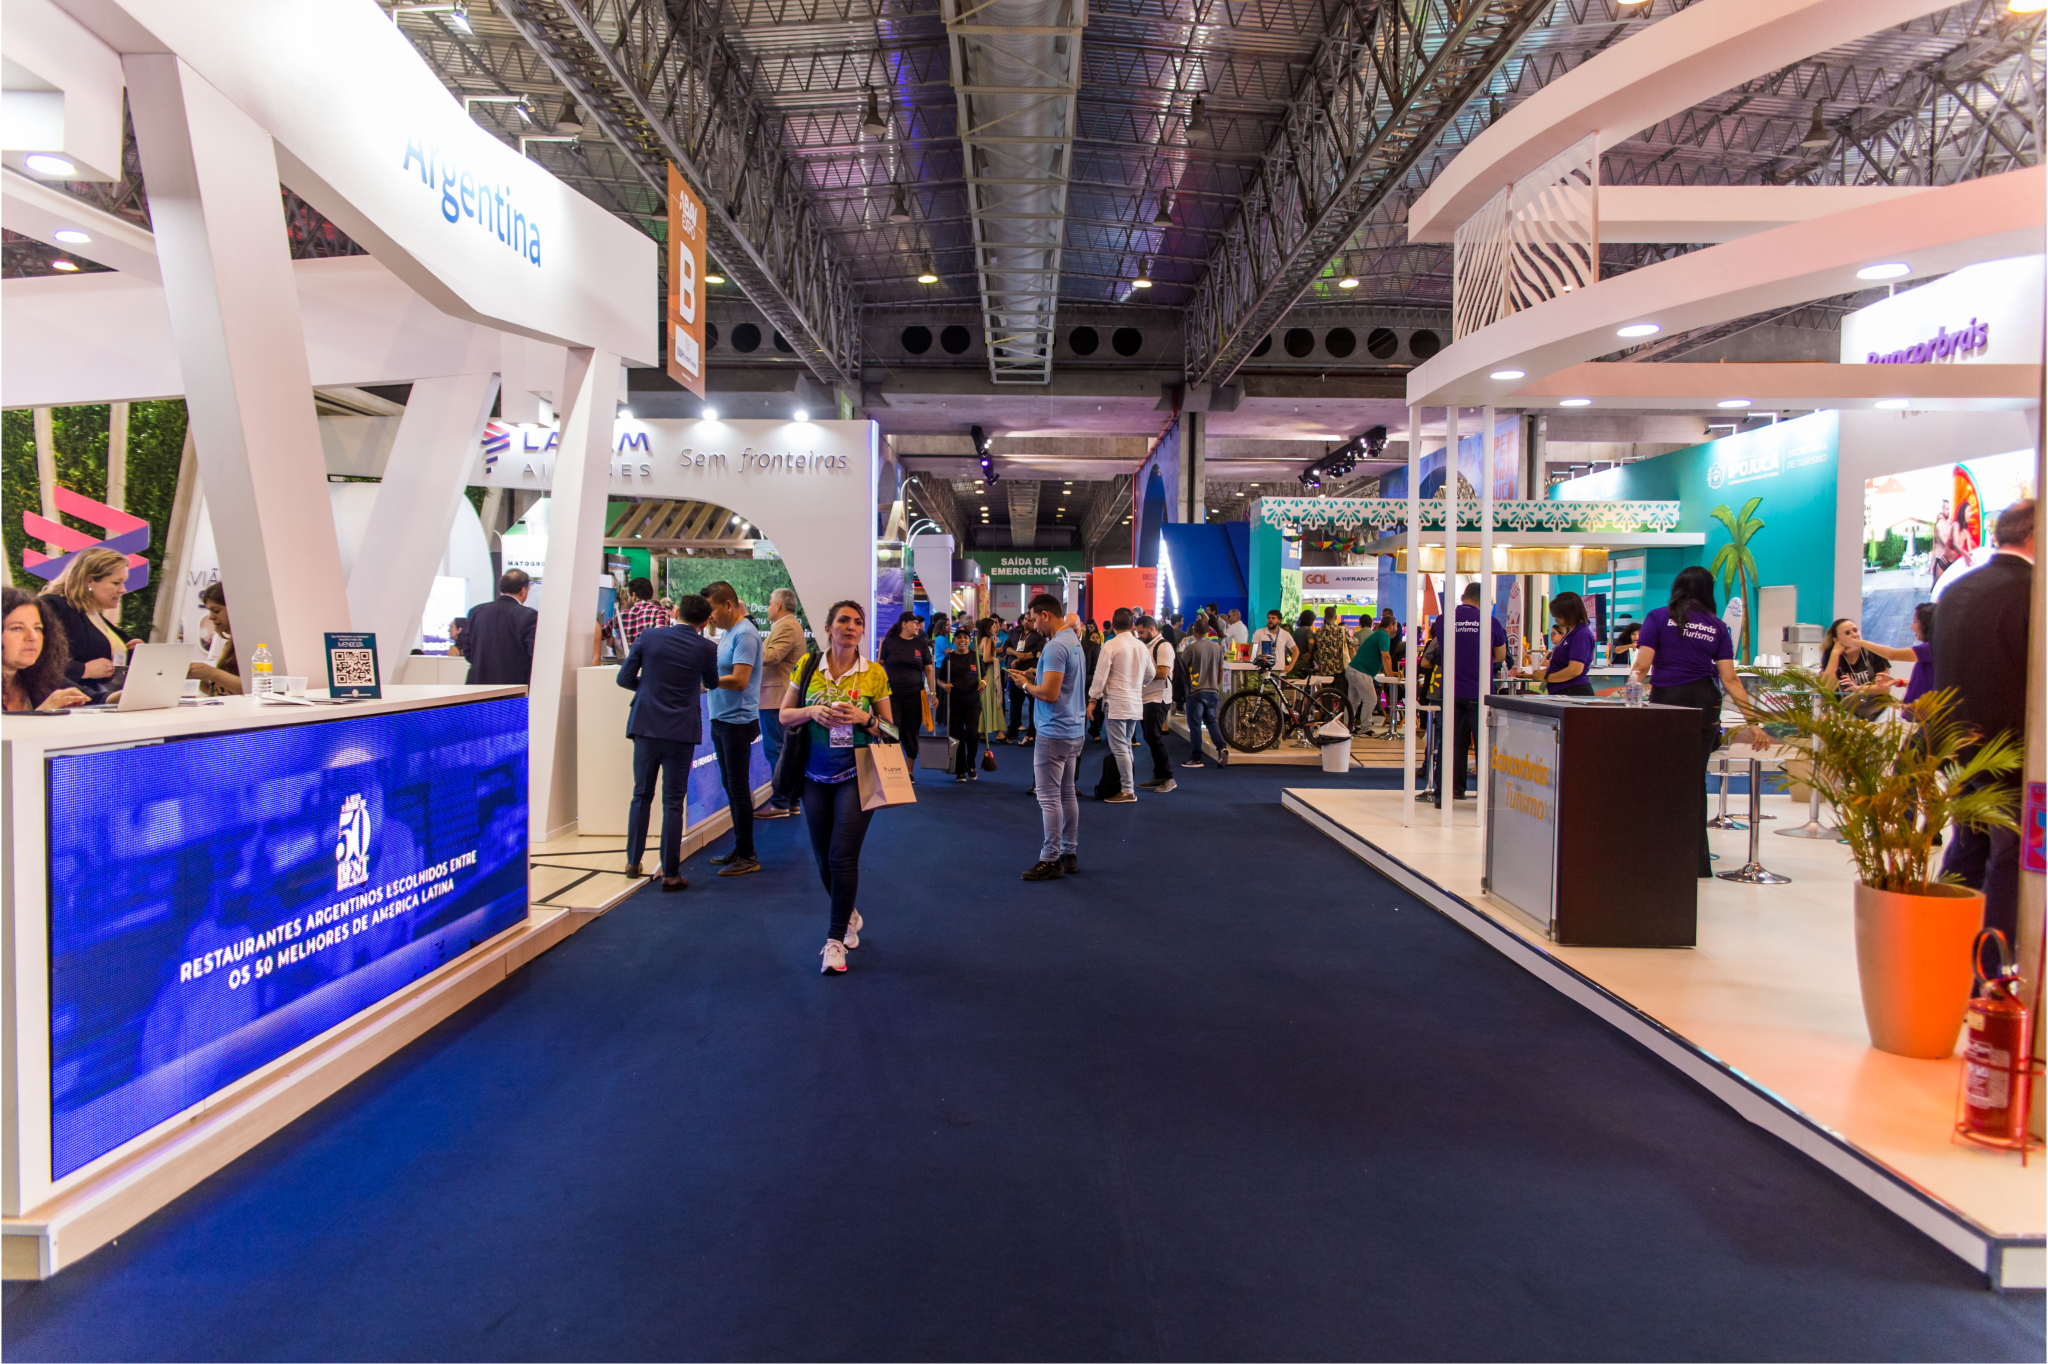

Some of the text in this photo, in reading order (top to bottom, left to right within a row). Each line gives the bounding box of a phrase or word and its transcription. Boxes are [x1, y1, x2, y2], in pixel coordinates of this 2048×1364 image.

[403, 134, 541, 268] Argentina
[679, 241, 696, 324] B
[524, 431, 650, 451] LAM
[522, 463, 650, 477] AIES
[680, 447, 847, 473] Sem fronteiras
[1728, 453, 1780, 479] IPOJUCA
[1787, 454, 1827, 469] DE TURISMO
[1001, 556, 1049, 566] SAÍDA DE
[1305, 574, 1330, 585] GOL
[1683, 628, 1714, 643] Turismo
[826, 687, 847, 698] EU
[1490, 745, 1548, 786] Bancorbrás
[1505, 781, 1545, 820] Turismo
[335, 807, 371, 861] 50
[180, 849, 477, 983] RESTAURANTES ARGENTINOS ESCOLHIDOS ENTRE
[228, 878, 455, 990] OS 50 MELHORES DE AMERICA LATINA
